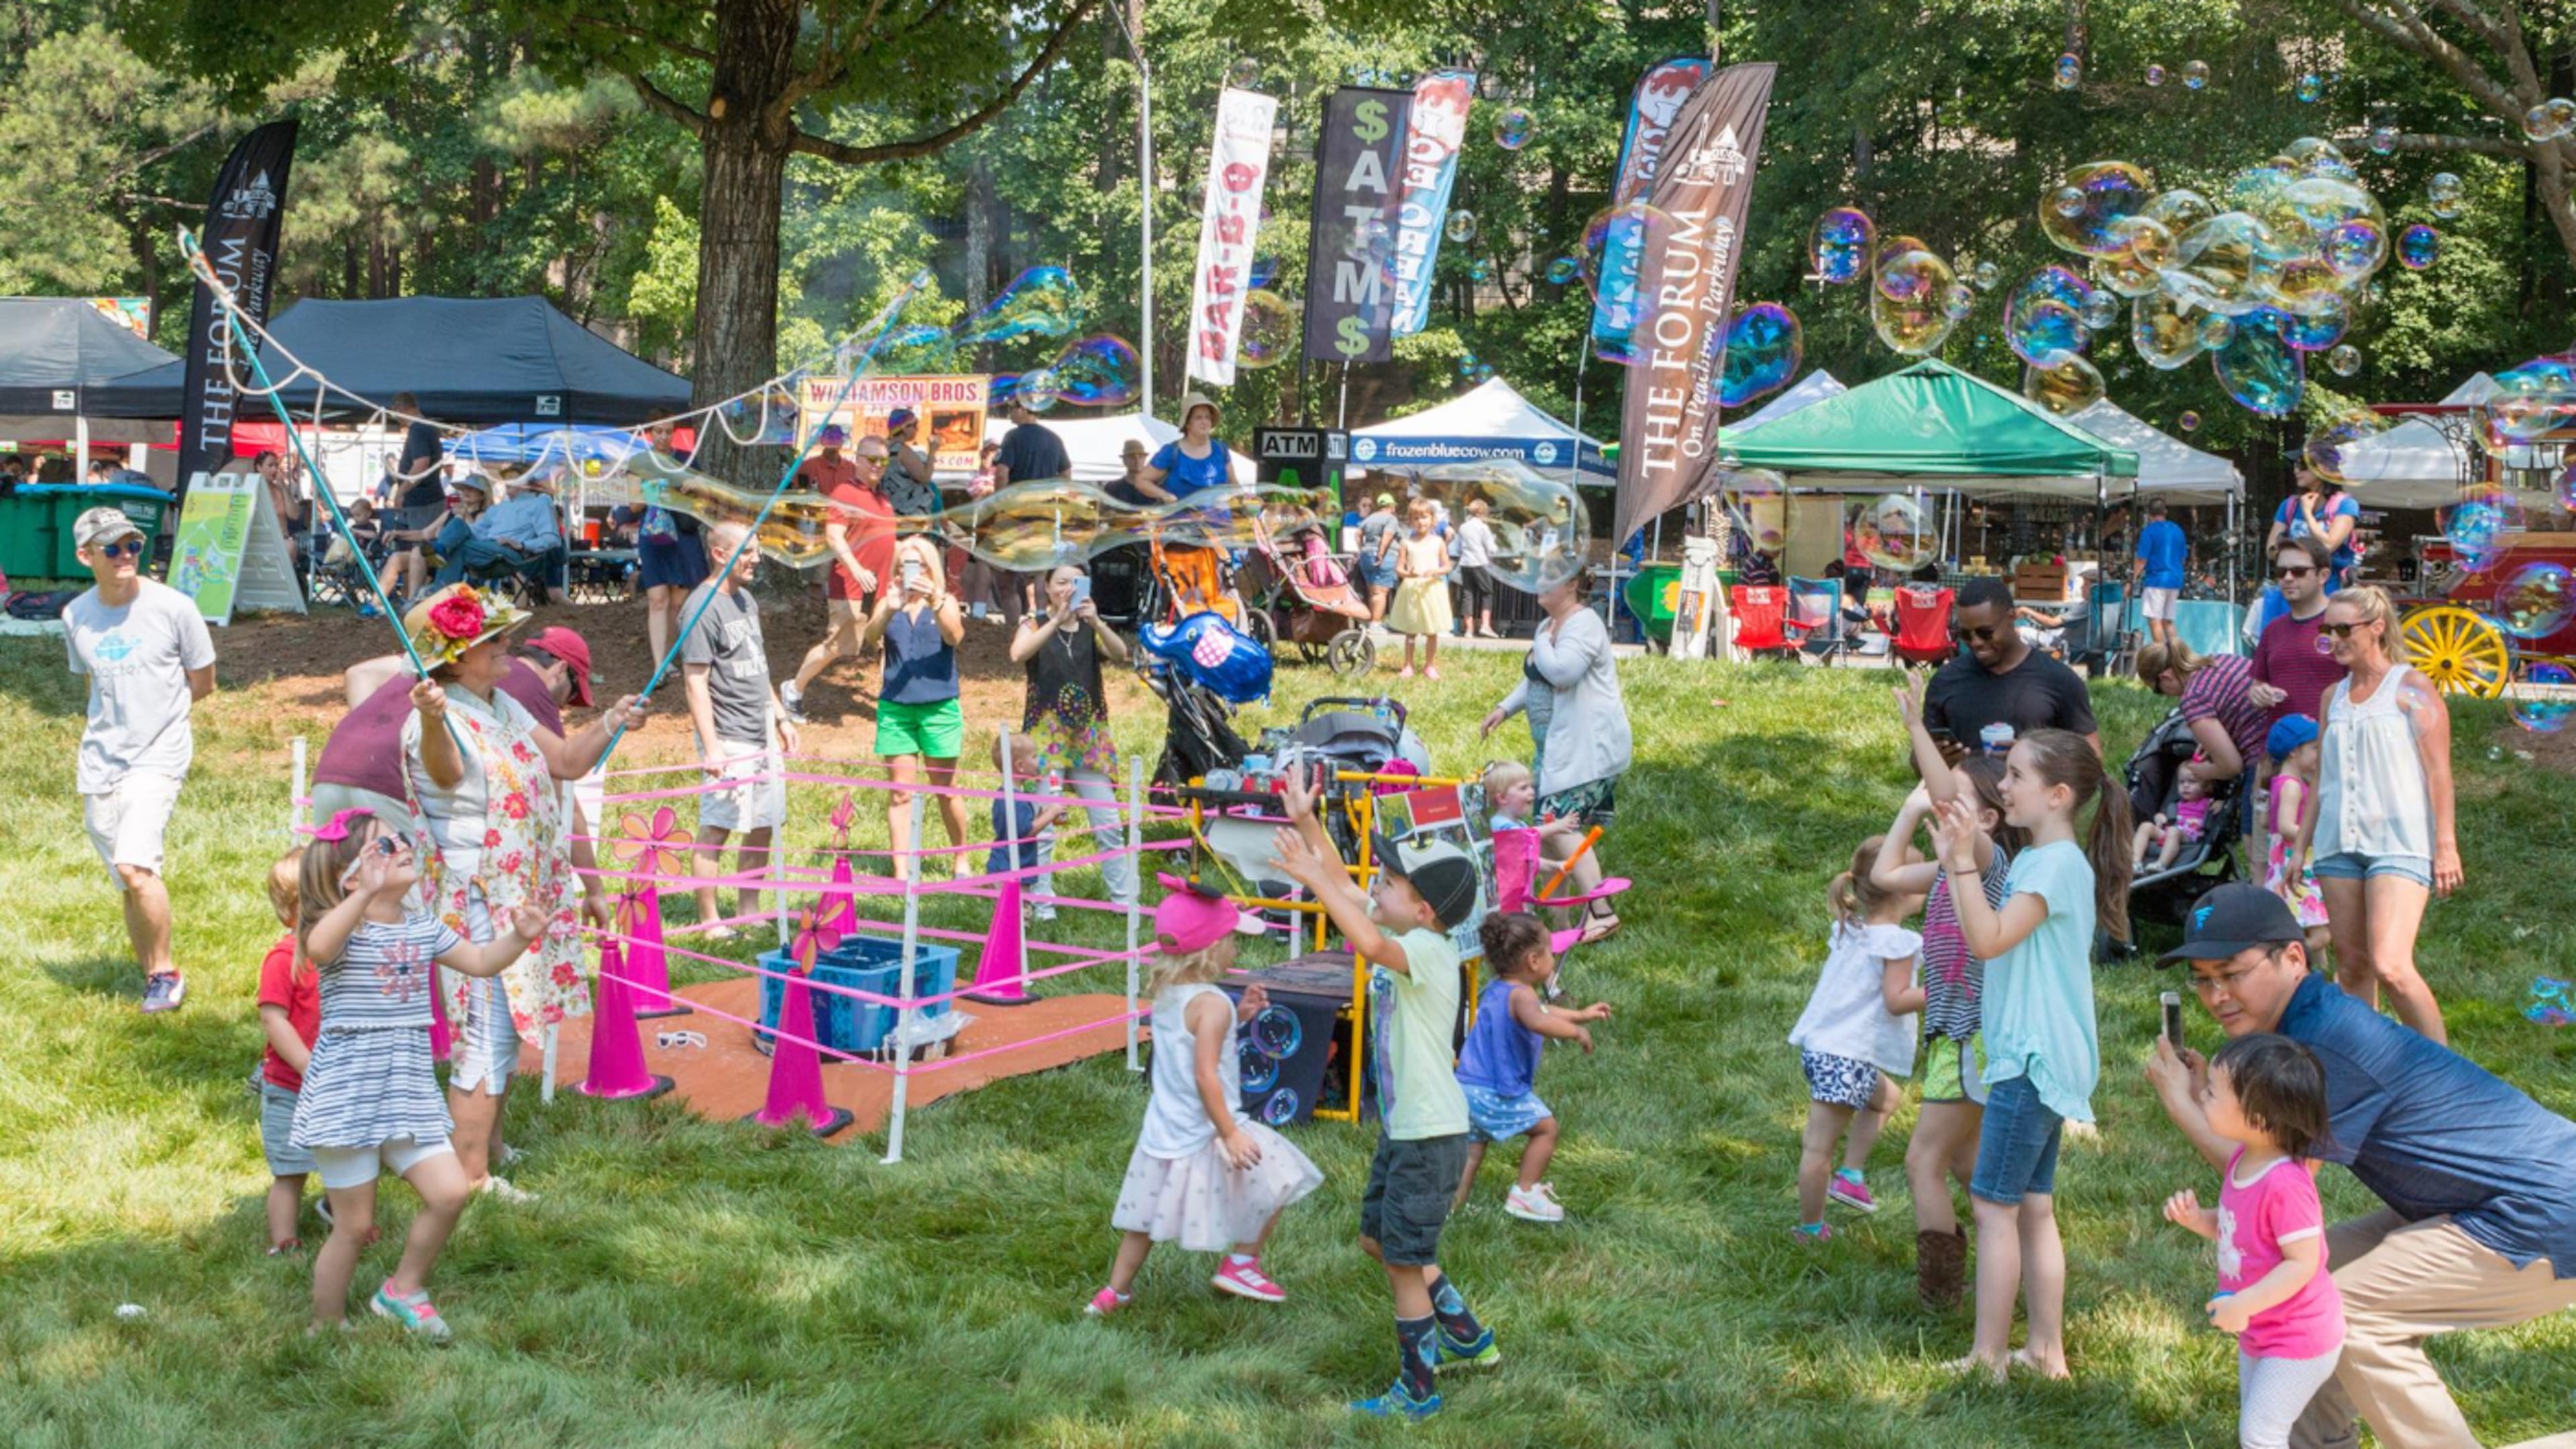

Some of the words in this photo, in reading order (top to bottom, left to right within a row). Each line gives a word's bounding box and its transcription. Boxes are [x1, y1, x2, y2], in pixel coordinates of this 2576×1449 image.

[1651, 208, 1707, 372] FORUM
[1699, 221, 1736, 315] Parkway
[931, 382, 983, 402] BROS.
[1684, 321, 1717, 418] Peachtree
[200, 379, 233, 451] THE
[1265, 437, 1315, 453] ATM
[1642, 386, 1684, 478] THE
[1681, 422, 1704, 458] On
[1387, 443, 1525, 460] frozenbluecow.com
